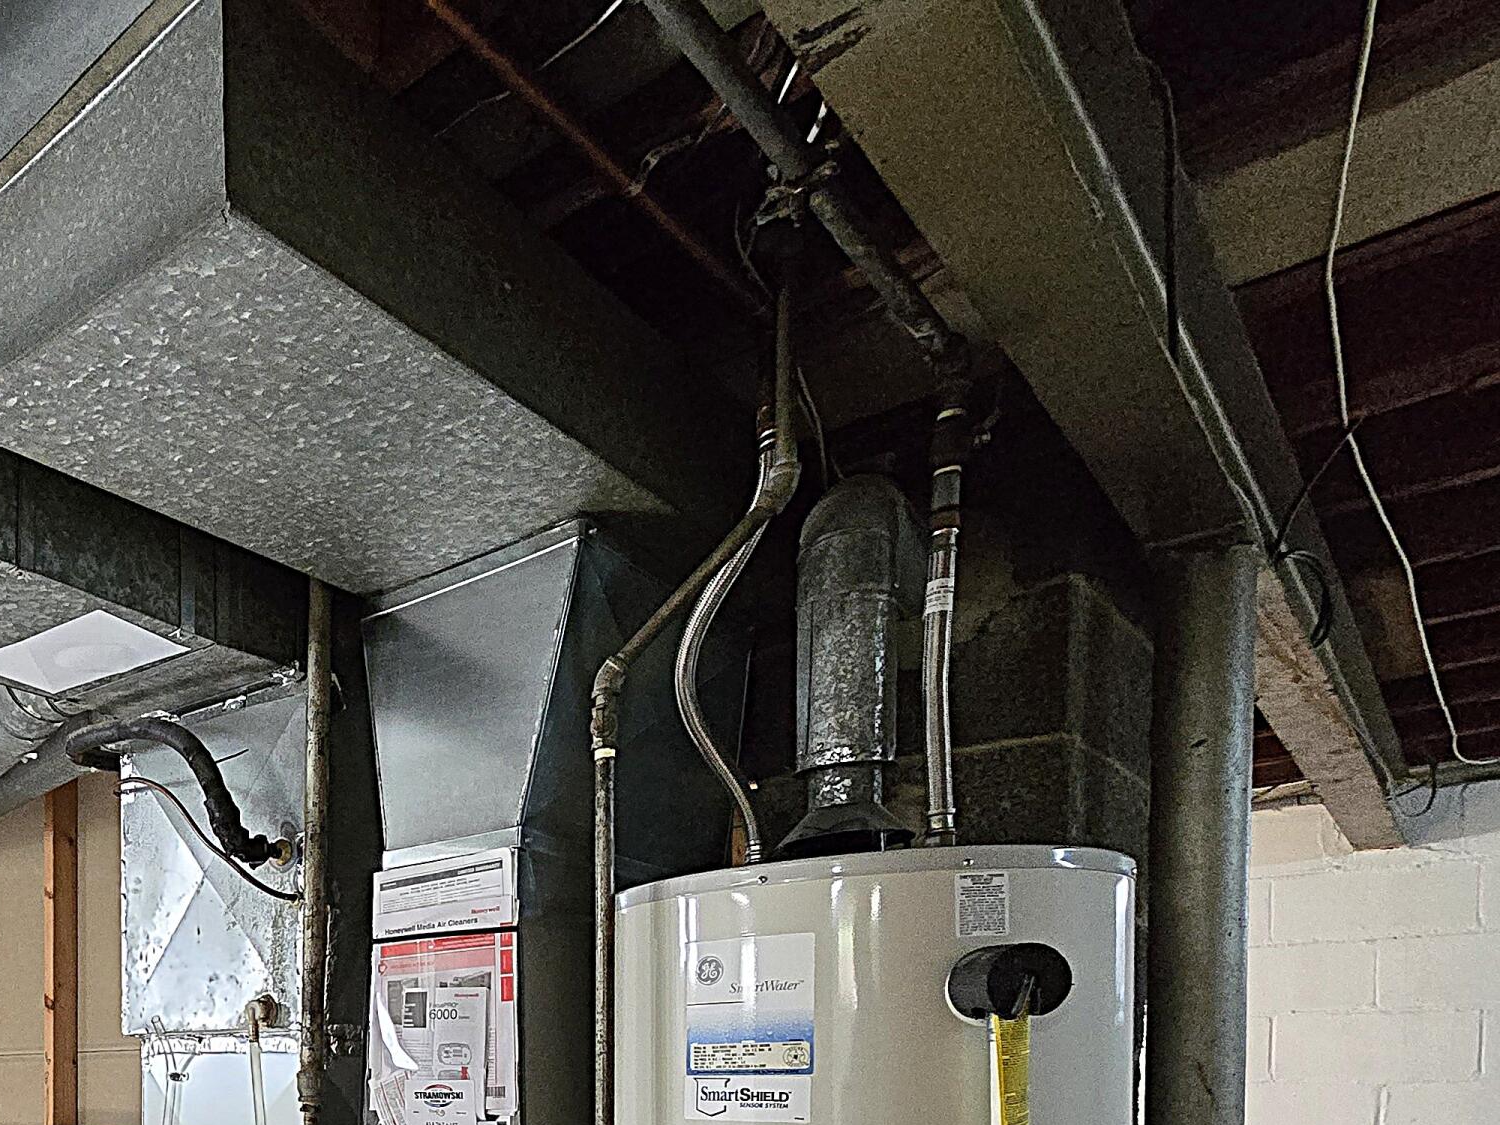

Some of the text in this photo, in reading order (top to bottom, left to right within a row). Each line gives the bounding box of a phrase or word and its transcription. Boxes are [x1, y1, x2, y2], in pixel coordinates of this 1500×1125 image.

[385, 917, 479, 936] Honeywell Media Air Cleaners
[429, 1008, 458, 1020] 6000
